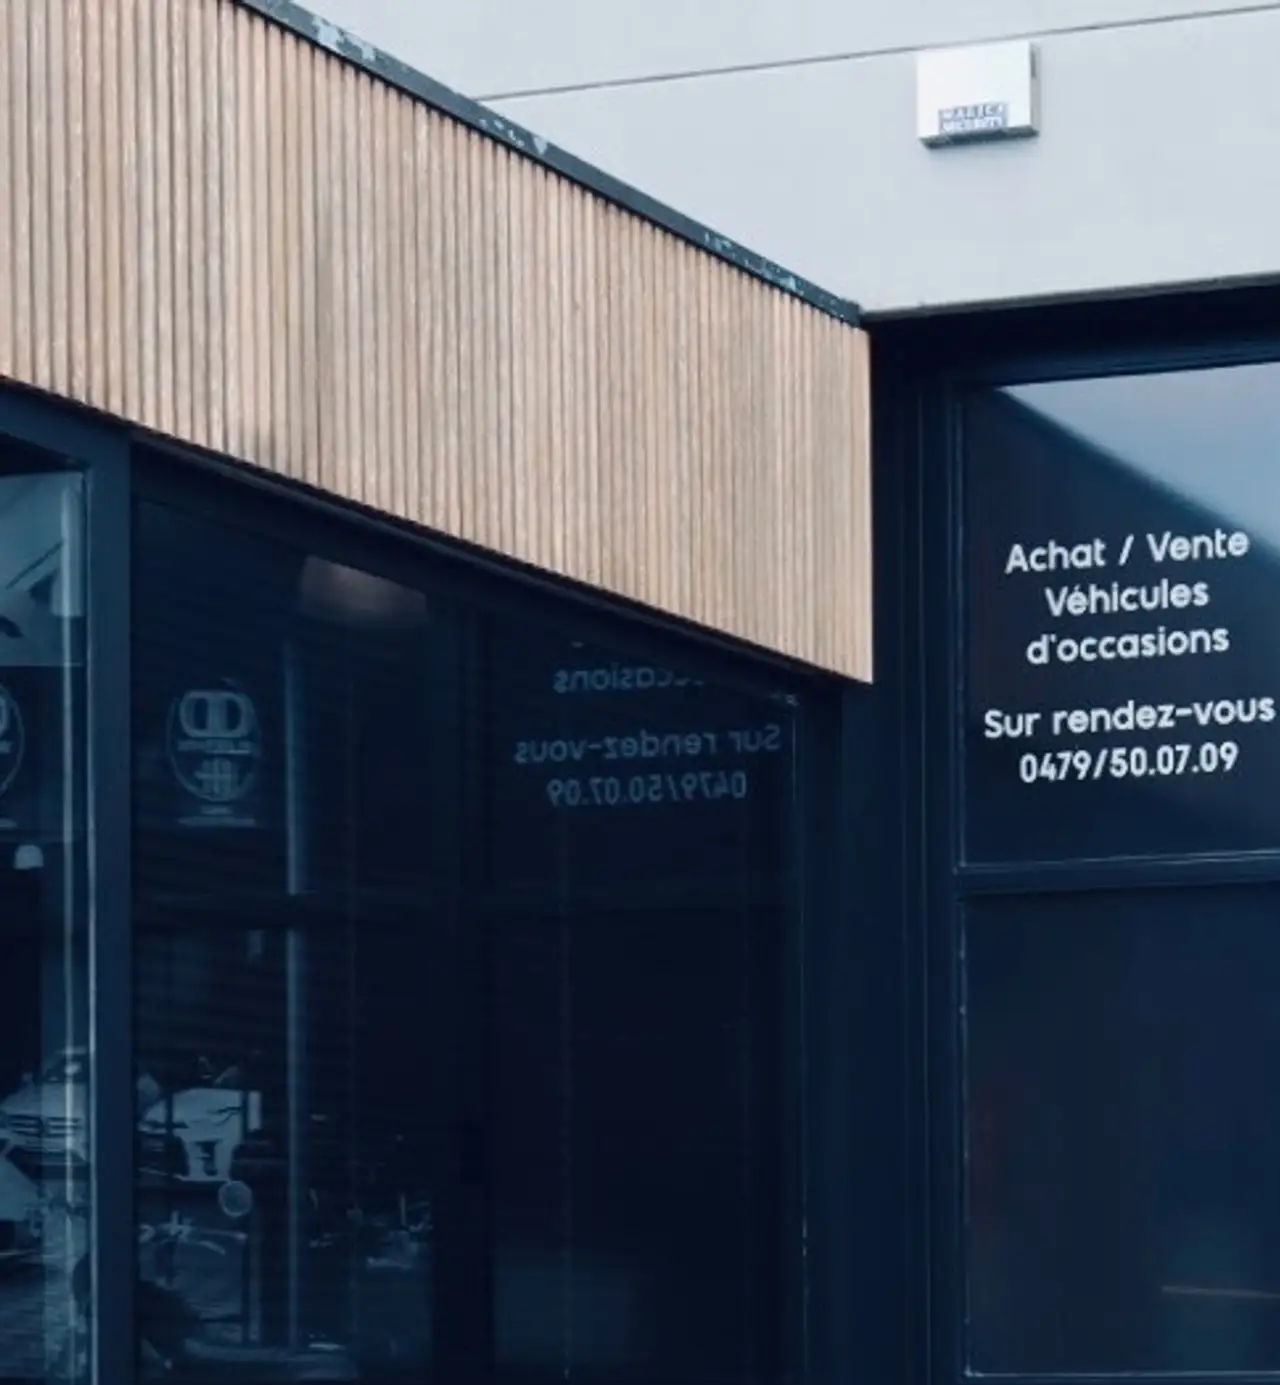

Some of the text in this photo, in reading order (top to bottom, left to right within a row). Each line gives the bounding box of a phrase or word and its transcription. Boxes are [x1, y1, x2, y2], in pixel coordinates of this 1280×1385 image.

[1005, 528, 1249, 574] Achat / Vente
[1045, 578, 1210, 616] Véhicules
[1026, 626, 1230, 665] d'occasions
[984, 697, 1276, 738] Sur rendez-vous
[1019, 741, 1239, 783] 0479/50.07.09
